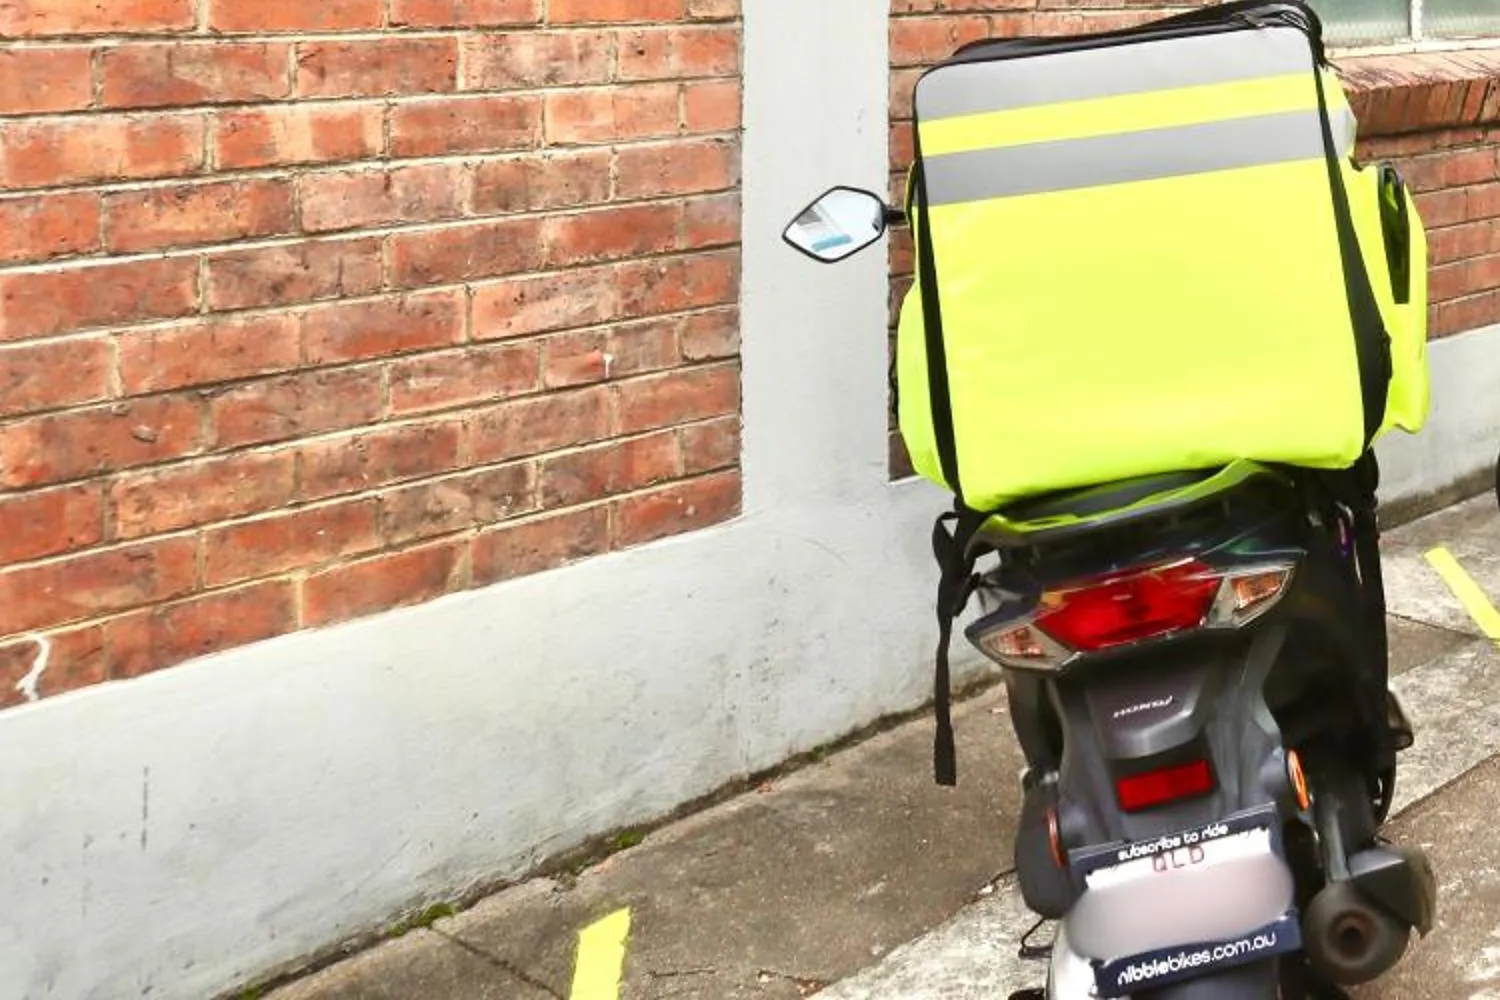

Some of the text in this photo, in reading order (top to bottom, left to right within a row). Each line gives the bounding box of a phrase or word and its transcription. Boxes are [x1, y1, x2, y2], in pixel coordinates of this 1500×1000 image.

[1117, 823, 1229, 861] subscribe to ride
[1152, 845, 1205, 873] QLD
[1117, 931, 1277, 985] nibblebikes.com.au
